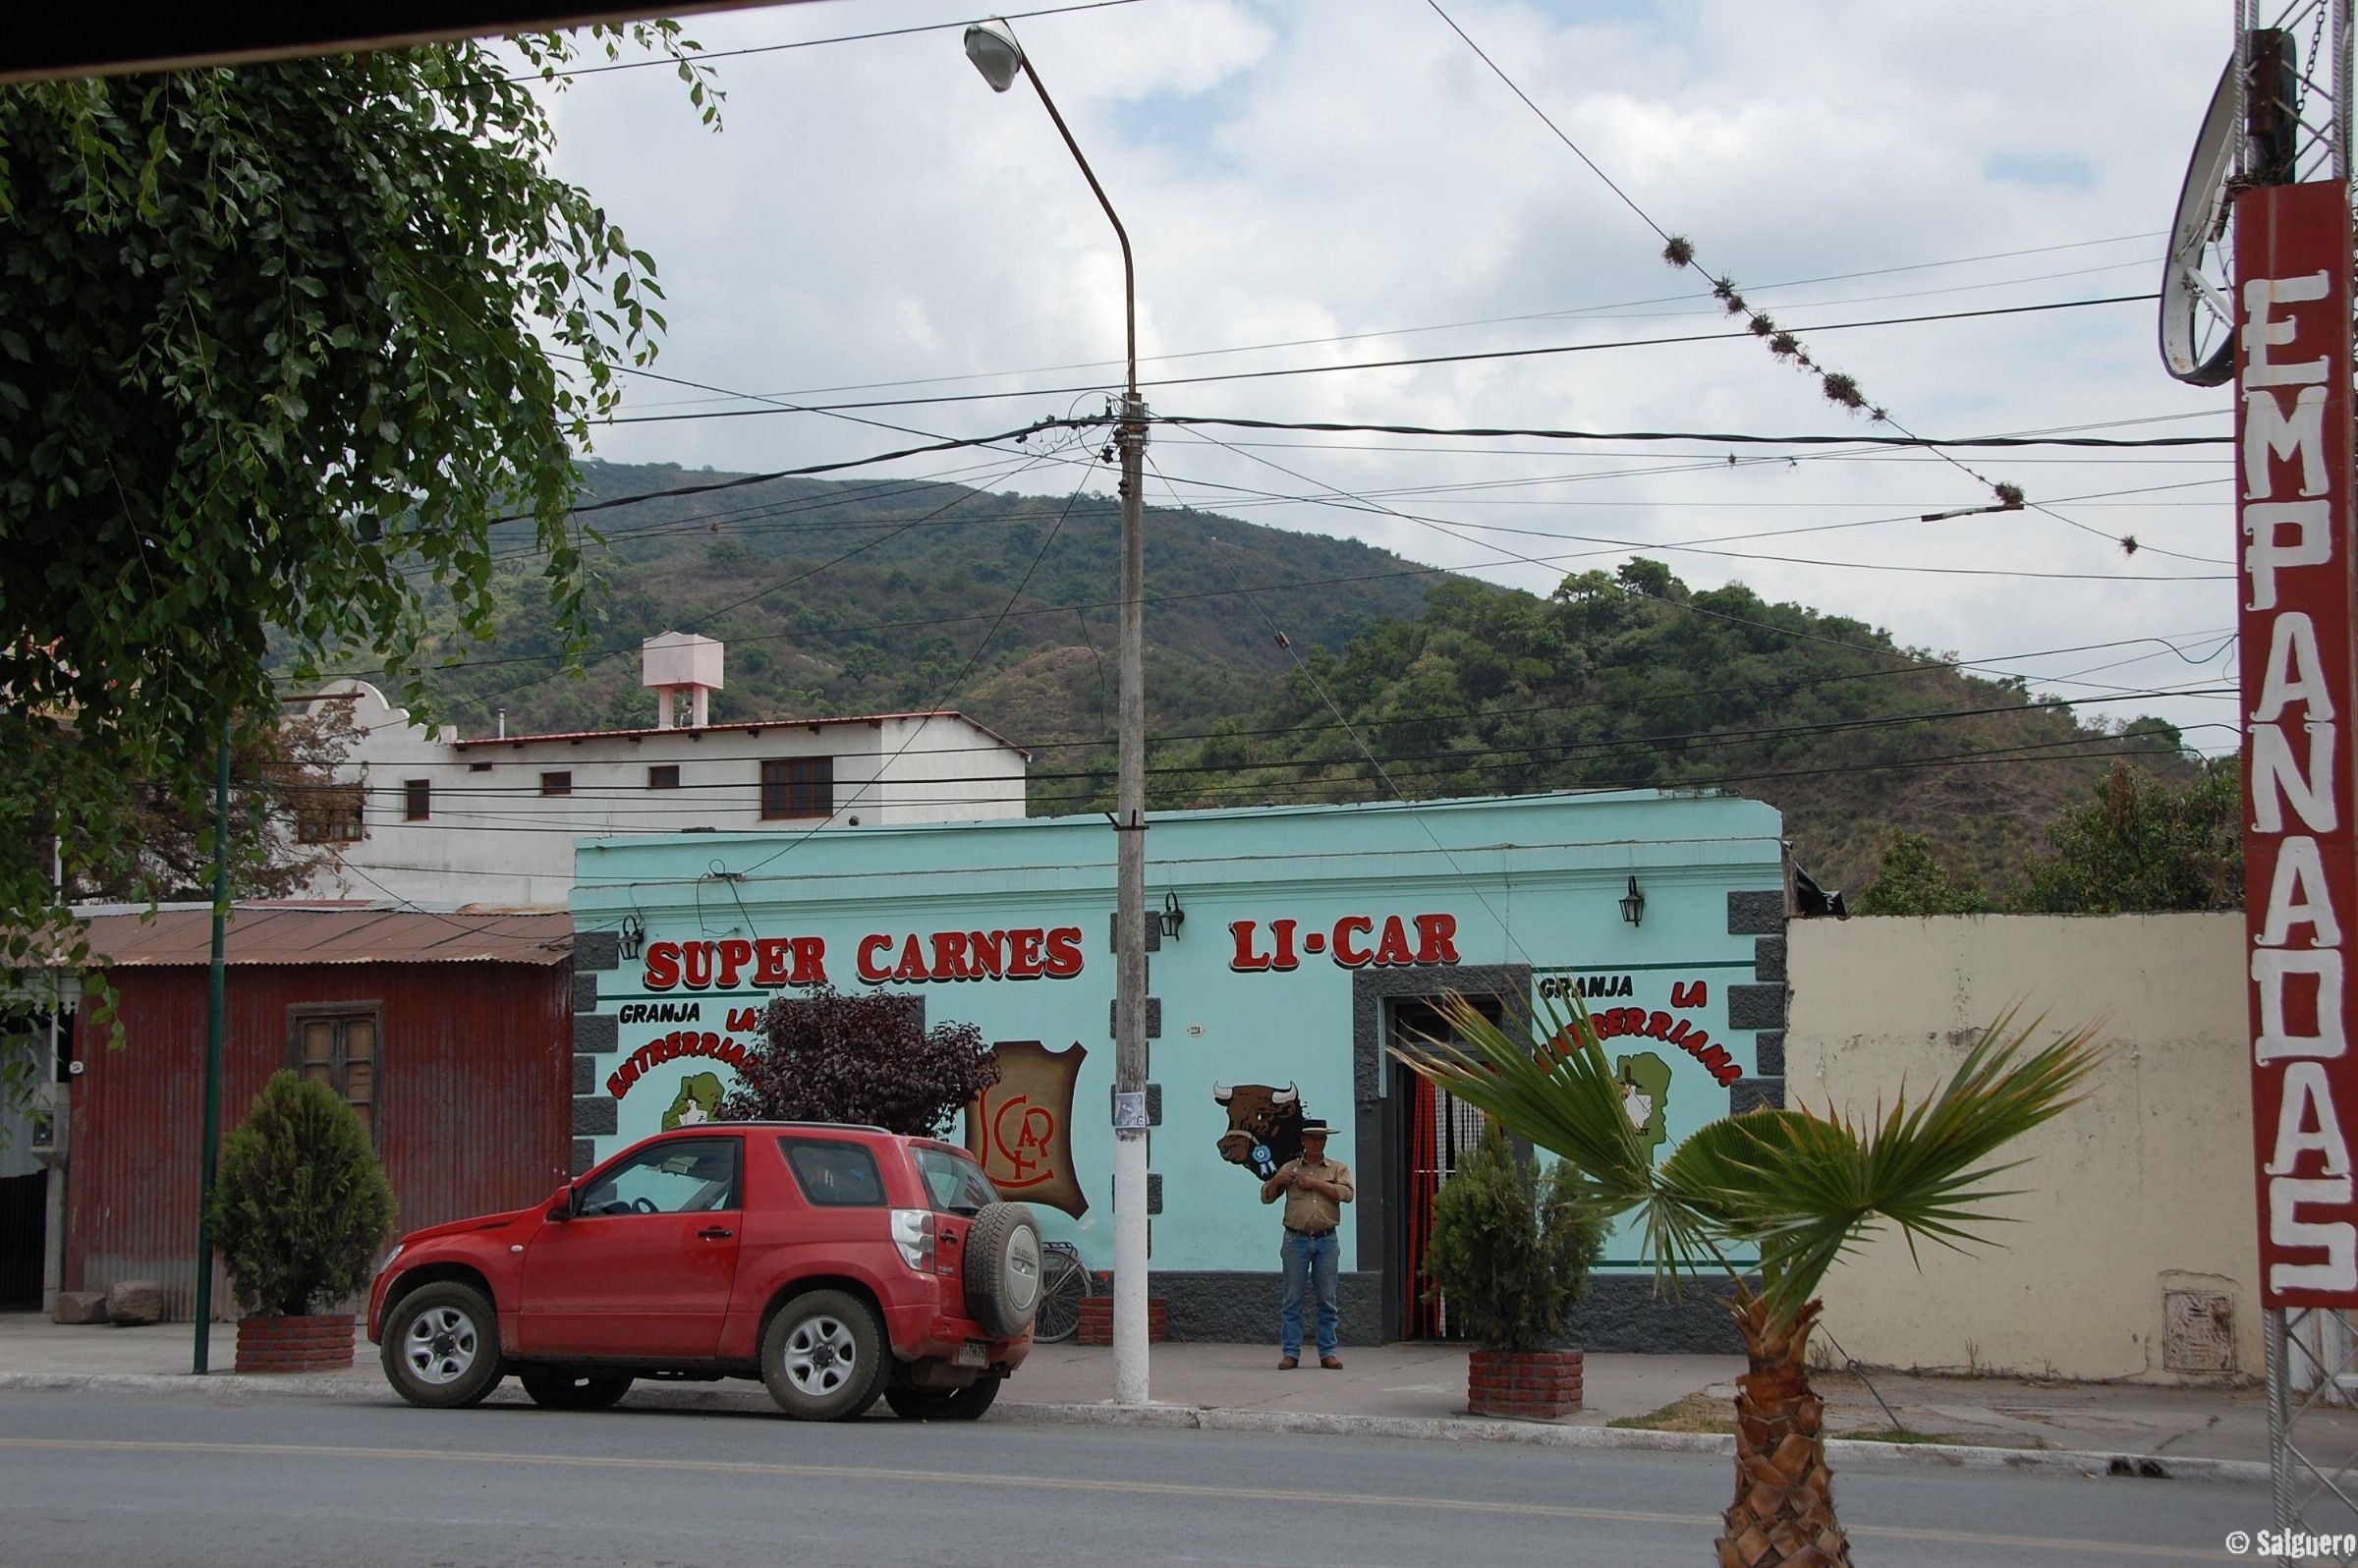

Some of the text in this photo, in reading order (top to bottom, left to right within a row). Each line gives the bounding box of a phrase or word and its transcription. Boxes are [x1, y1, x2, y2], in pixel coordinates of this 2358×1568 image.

[2243, 270, 2357, 1295] EMPANADAS
[644, 936, 827, 991] SUPER
[856, 926, 1085, 985] CARNES
[1540, 976, 1633, 998] GRANJA
[1671, 980, 1707, 1008] LA
[620, 1003, 700, 1024] GRANJA
[726, 1008, 755, 1032] LA
[606, 1032, 765, 1099] ENTRERRIA
